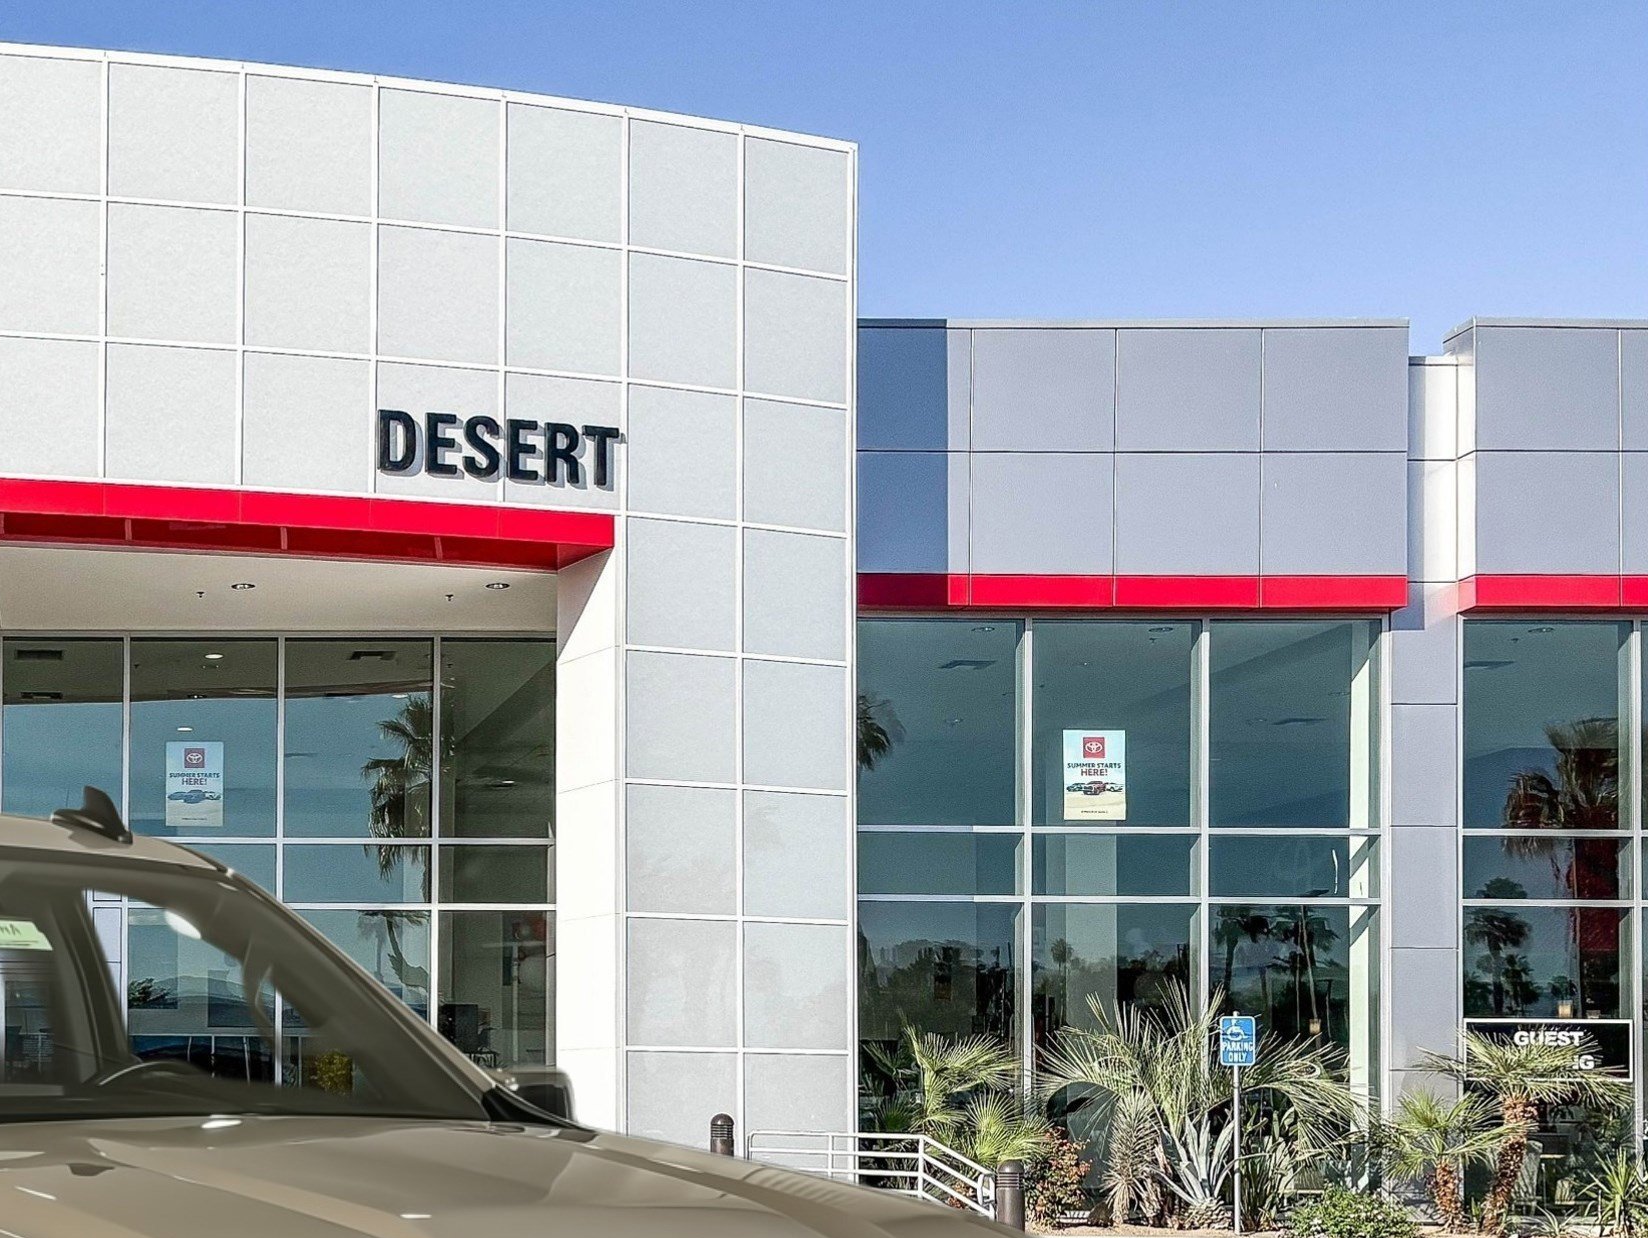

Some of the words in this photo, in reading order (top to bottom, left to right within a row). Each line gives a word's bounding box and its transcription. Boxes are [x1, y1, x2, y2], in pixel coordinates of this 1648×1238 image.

[377, 409, 620, 487] DESERT
[1080, 768, 1108, 776] HERE!
[181, 778, 208, 786] HERE!
[1513, 1031, 1585, 1047] GUEST
[1221, 1041, 1253, 1052] PARKING
[1228, 1052, 1247, 1062] ONLY
